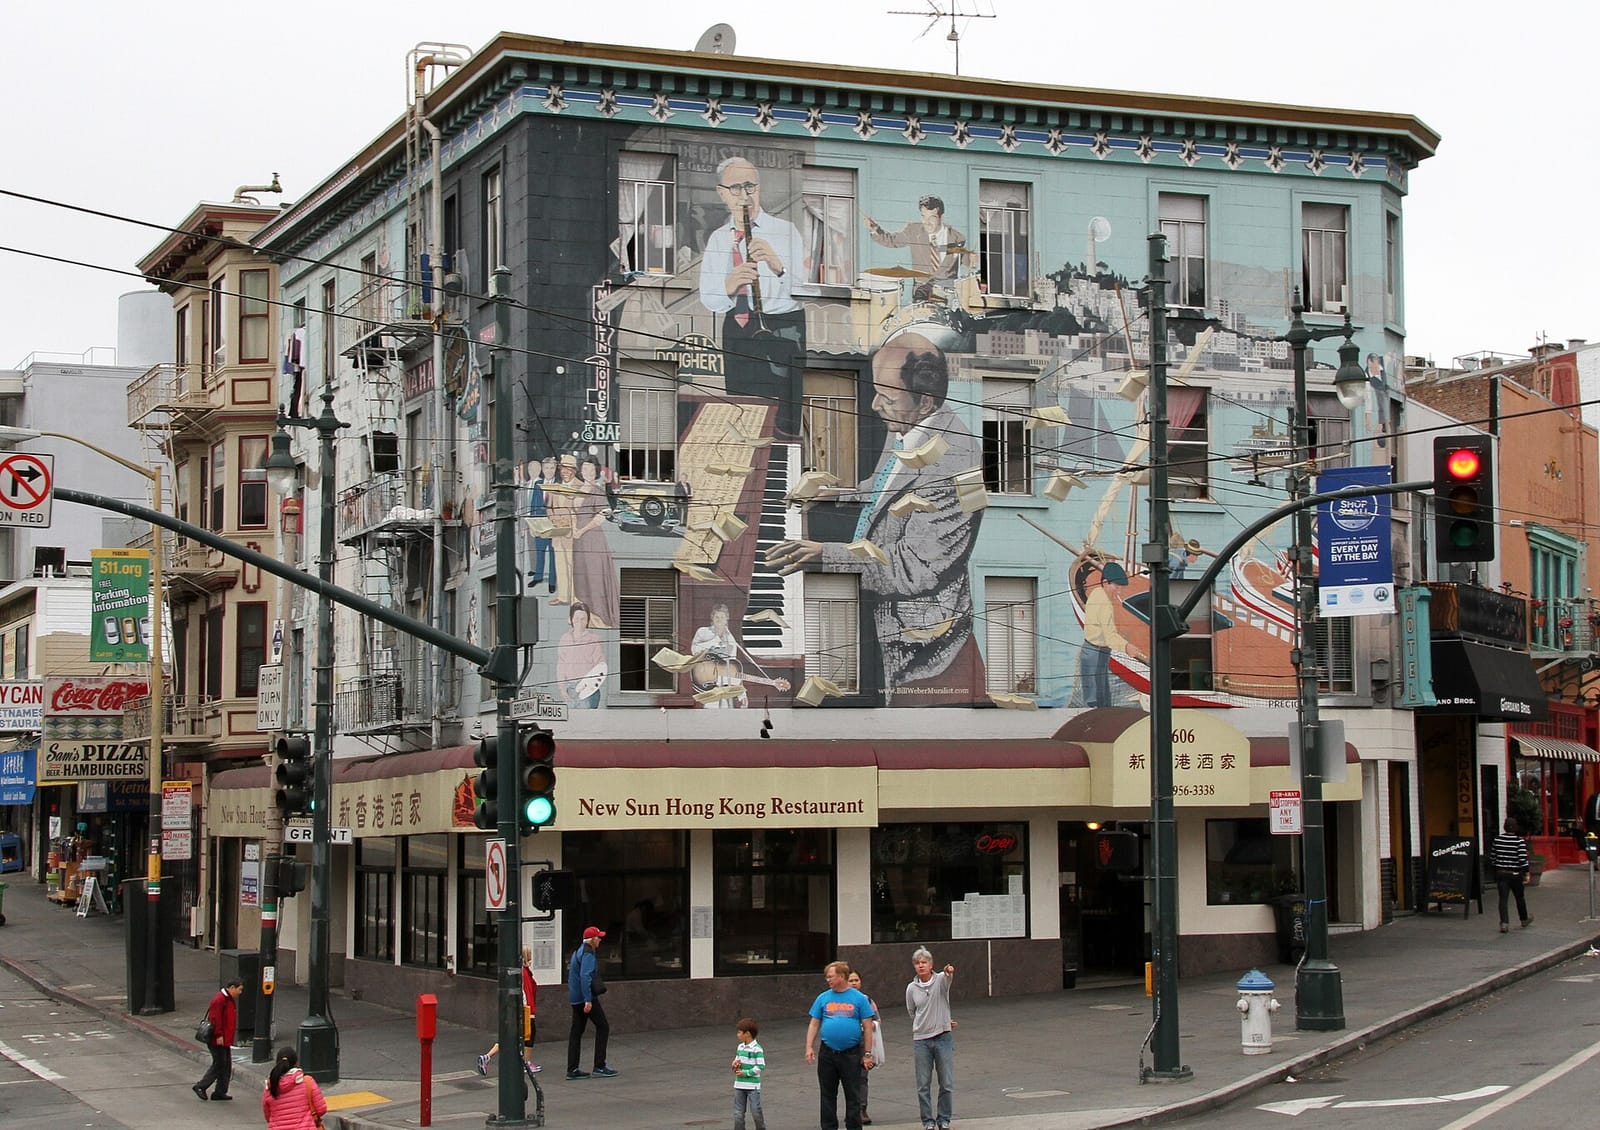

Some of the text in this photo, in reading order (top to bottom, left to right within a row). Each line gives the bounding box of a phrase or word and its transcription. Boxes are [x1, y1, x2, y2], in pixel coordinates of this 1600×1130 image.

[597, 289, 608, 412] MULIN ROUGE
[1340, 500, 1368, 509] SHOP
[21, 512, 44, 523] RED
[1331, 543, 1378, 554] EVERY DAY
[1331, 551, 1379, 562] BY THE BAY
[100, 561, 142, 577] 511.org
[99, 580, 112, 588] FREE
[95, 588, 130, 602] Parking
[93, 595, 149, 613] Information
[1406, 594, 1416, 701] HOTEL
[261, 672, 282, 686] RIGHT
[11, 686, 43, 704] CAN
[260, 690, 281, 705] TURN
[259, 708, 280, 723] ONLY
[513, 702, 536, 715] BROADWAY
[46, 743, 149, 762] Sam's PIZZA
[1128, 752, 1236, 770] 新港酒家
[64, 763, 144, 777] HAMBURGERS
[221, 806, 235, 824] New
[235, 805, 249, 823] Sun
[338, 789, 422, 828] 新香港酒家
[578, 797, 865, 820] New Sun Hong Kong Restaurant
[1280, 809, 1292, 817] ANY
[1280, 817, 1293, 825] TIME
[290, 829, 348, 840] GRNT
[977, 834, 1016, 852] Open
